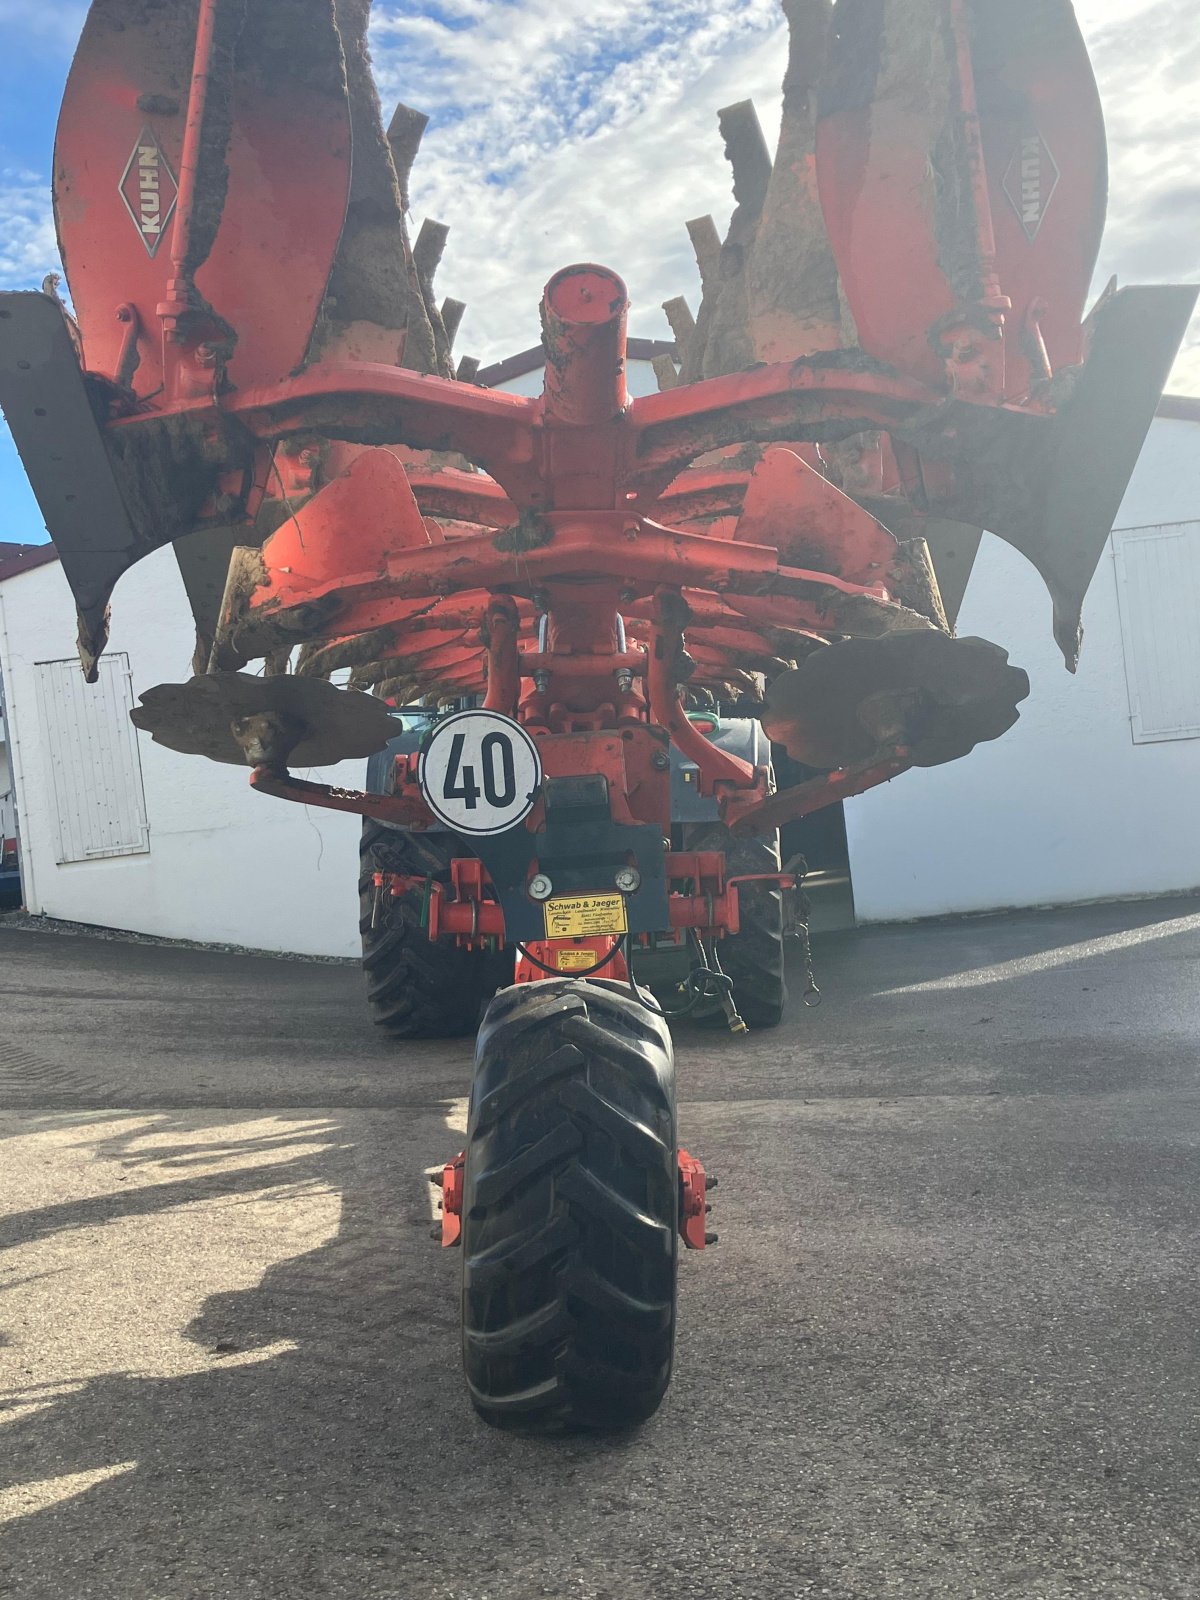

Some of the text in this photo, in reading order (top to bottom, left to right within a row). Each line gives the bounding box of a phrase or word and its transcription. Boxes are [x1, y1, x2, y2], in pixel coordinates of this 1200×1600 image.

[138, 146, 160, 233] KUHN
[1021, 136, 1041, 223] KUHN
[443, 731, 516, 809] 40
[547, 902, 581, 912] Schwab
[592, 899, 620, 908] Jaeger
